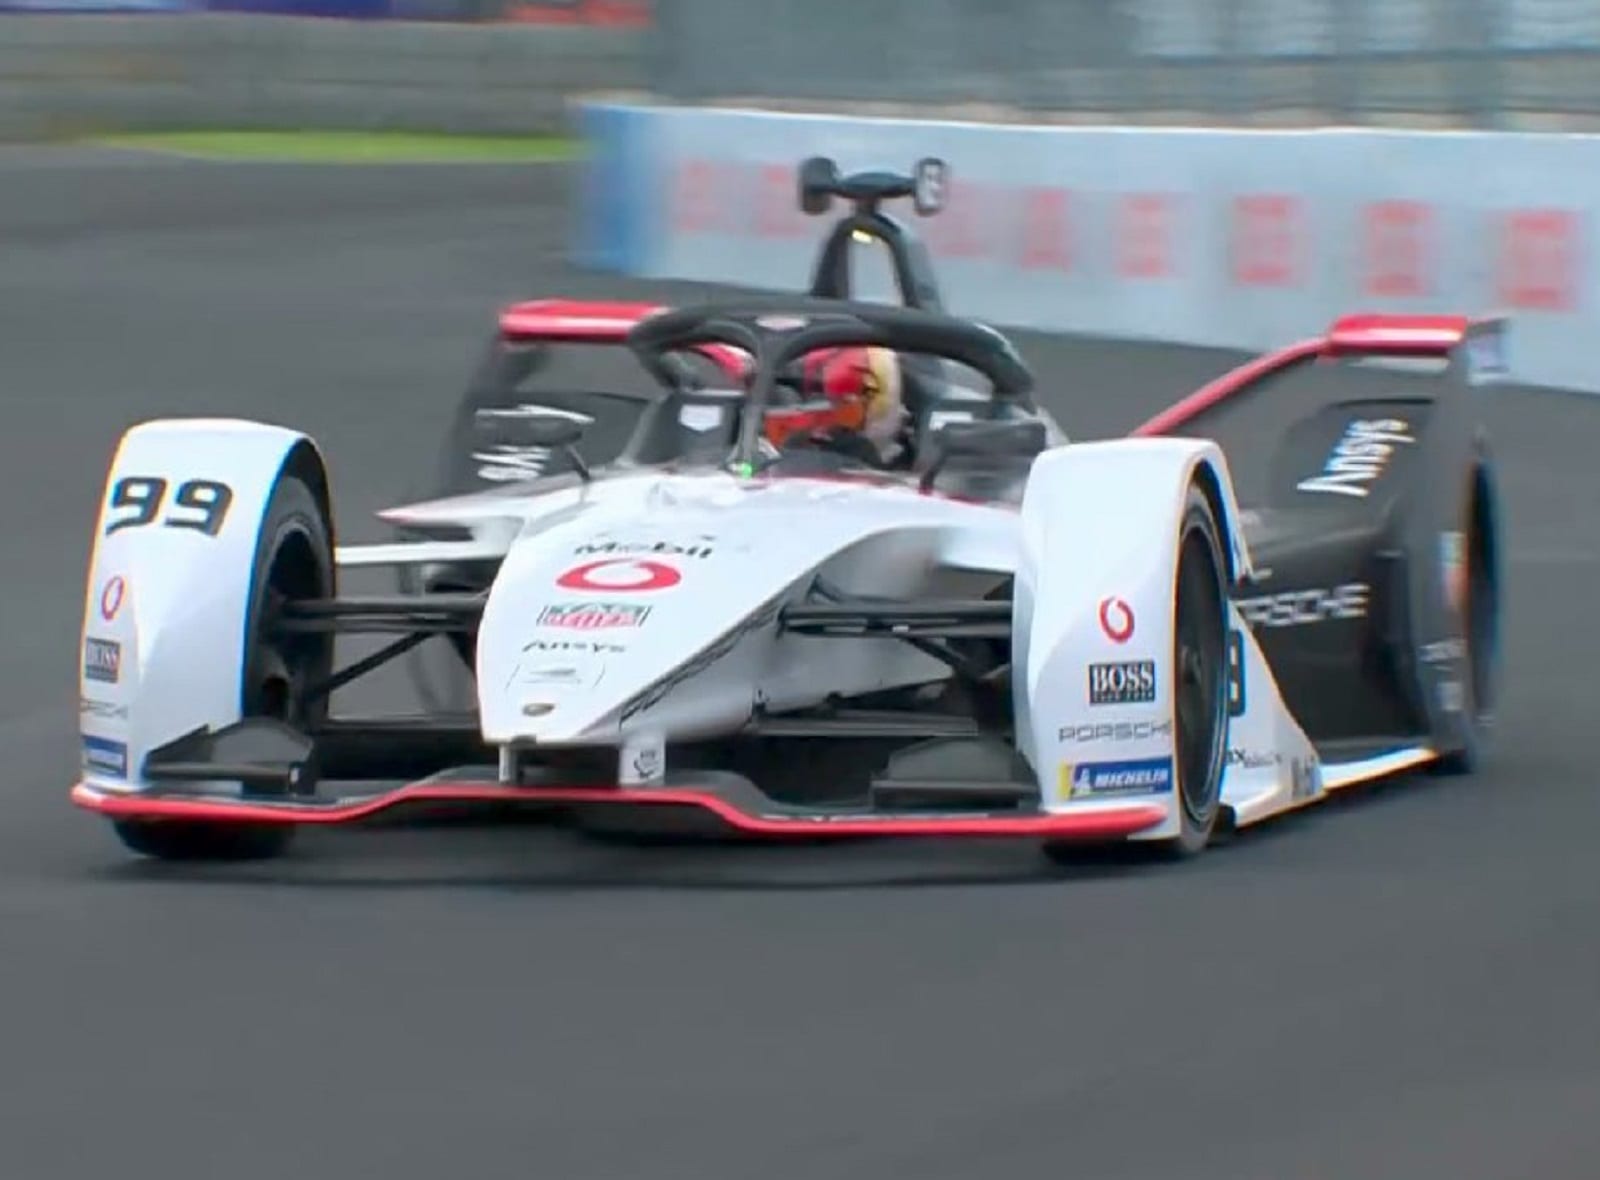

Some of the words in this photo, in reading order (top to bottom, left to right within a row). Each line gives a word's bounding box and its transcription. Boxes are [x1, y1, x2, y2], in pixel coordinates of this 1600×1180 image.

[106, 476, 233, 537] 99
[1092, 664, 1153, 693] BOSS
[1059, 721, 1171, 742] PORSCH
